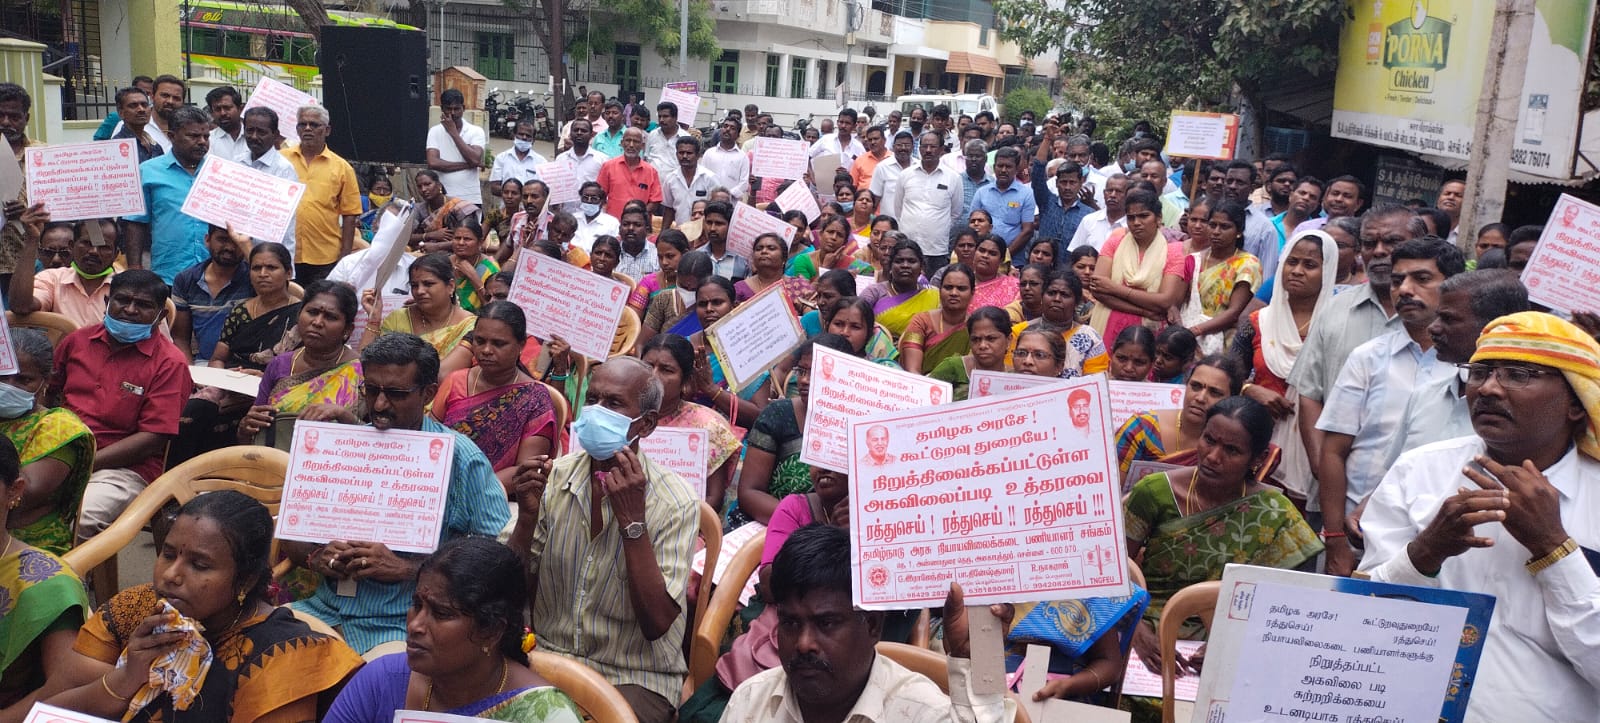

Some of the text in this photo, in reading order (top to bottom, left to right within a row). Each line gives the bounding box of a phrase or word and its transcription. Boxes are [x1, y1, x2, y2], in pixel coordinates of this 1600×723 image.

[1387, 32, 1444, 64] PORNA
[1394, 70, 1430, 89] Chicken
[1528, 151, 1551, 168] 76074
[848, 370, 879, 383] தமிழக
[882, 380, 907, 390] அரசே
[838, 378, 877, 394] கூட்டுறவு
[880, 390, 918, 404] துறையே
[916, 425, 972, 444] தமிழக
[977, 414, 1026, 431] அரசே
[335, 438, 369, 448] தமிழக
[372, 441, 402, 449] அரசே
[900, 444, 970, 462] கூட்டுறவு
[974, 431, 1048, 455] துறையே
[322, 448, 366, 460] கூட்டுறவு
[368, 453, 414, 462] துறையே
[302, 460, 434, 478] நிறுத்திவைக்கப்பட்டுள்ள
[873, 448, 1088, 492] நிறுத்திவைக்கப்பட்டுள்ள
[294, 474, 438, 493] அகவிலைப்படி உத்தரவை
[864, 472, 1104, 512] அகவிலைப்படி உத்தரவை
[292, 485, 328, 501] ரத்துசெய்
[338, 489, 375, 505] ரத்துசெய்
[387, 494, 425, 509] ரத்துசெய்
[867, 514, 925, 542] ரத்துசெய்
[942, 505, 1002, 534] ரத்துசெய்
[1024, 494, 1087, 526] ரத்துசெய்
[863, 523, 1111, 562] தமிழ்நாடு அரசு நியாயவிலைக்கடை பணியாளர் சங்கம்
[1269, 604, 1338, 621] தமிழக அரசே!
[1266, 619, 1313, 632] ரத்துசெய்!
[1362, 618, 1440, 632] கூட்டுறவுதுறையே!
[1393, 635, 1437, 647] ரத்துசெய்!
[1309, 655, 1385, 674] நிறுத்தப்பட்ட
[1301, 675, 1386, 695] அகவிலை படி
[1293, 689, 1386, 709] சுற்றறிக்கையை
[1263, 704, 1339, 722] உடனடியாக
